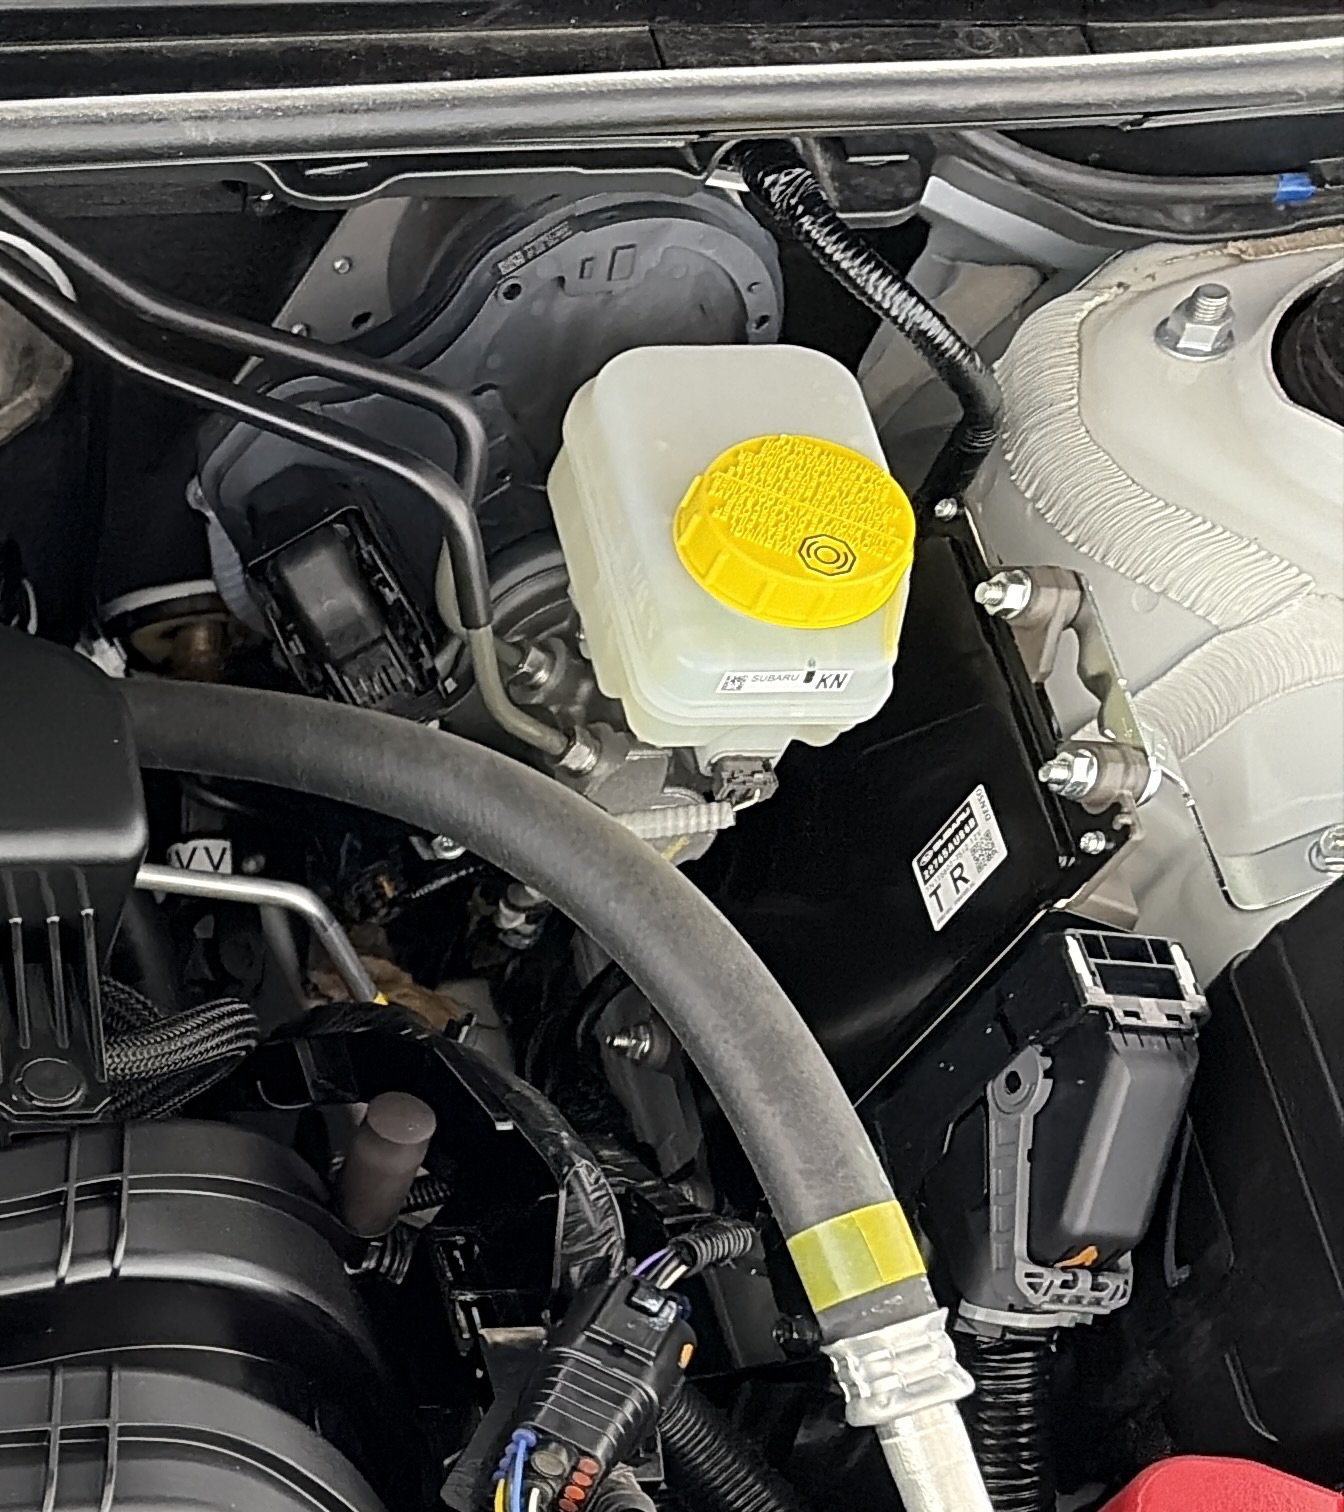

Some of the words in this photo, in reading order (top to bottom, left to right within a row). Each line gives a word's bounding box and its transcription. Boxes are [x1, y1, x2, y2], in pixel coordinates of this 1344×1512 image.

[751, 674, 800, 683] SUBARU
[815, 673, 848, 690] KN
[975, 788, 992, 822] DENSO
[932, 806, 971, 851] SUBARU
